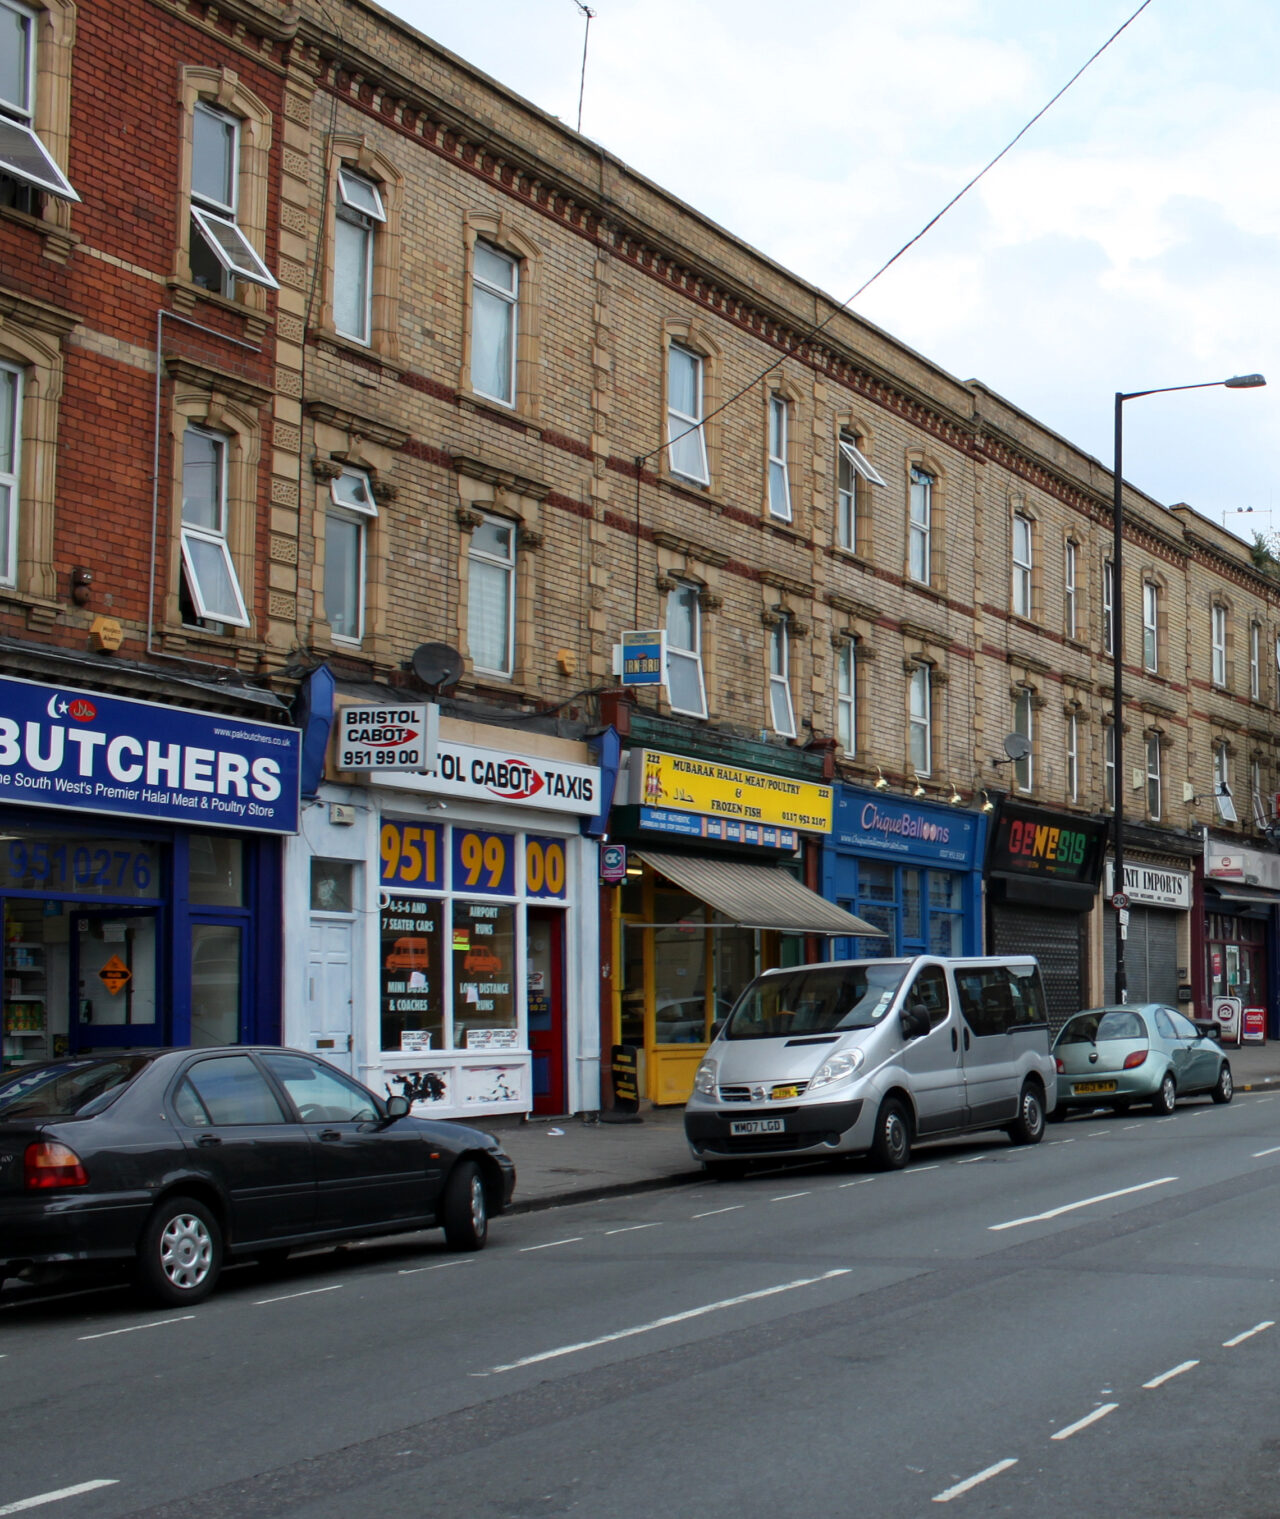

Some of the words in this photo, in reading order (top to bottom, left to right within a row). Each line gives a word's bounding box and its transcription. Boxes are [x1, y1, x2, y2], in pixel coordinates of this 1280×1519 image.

[624, 659, 660, 673] IRN-BRU
[346, 710, 420, 725] BRISTOL
[213, 727, 291, 747] www.pakbutchers.co.uk
[347, 728, 407, 743] CABOT
[343, 751, 372, 766] 951
[375, 750, 396, 765] 99
[399, 750, 419, 764] 00
[647, 753, 661, 764] 222
[471, 759, 532, 795] CABOT
[544, 771, 593, 801] TAXIS
[672, 760, 715, 778] MUBARAK
[716, 767, 743, 783] HALAL
[745, 774, 801, 795] MEAT/POULTRY
[15, 772, 51, 790] South
[55, 778, 92, 795] West's
[95, 784, 140, 801] Premier
[142, 789, 170, 804] Halal
[172, 793, 198, 808] Meat
[200, 796, 209, 809] &
[211, 798, 246, 817] Poultry
[248, 802, 275, 818] Store
[818, 788, 829, 799] 222
[711, 800, 743, 815] FROZEN
[744, 805, 762, 818] FISH
[782, 811, 797, 823] 0117
[799, 814, 811, 825] 952
[812, 816, 827, 828] 2107
[1009, 820, 1087, 865] GENESIS
[380, 824, 436, 882] 951
[460, 833, 505, 887] 99
[526, 841, 565, 894] 00
[1143, 871, 1183, 896] IMPORTS
[389, 901, 411, 914] 4-5-6
[412, 902, 428, 914] AND
[1114, 896, 1124, 905] 20
[469, 906, 498, 919] AIRPORT
[382, 919, 388, 930] 7
[389, 919, 415, 931] SEATER
[415, 920, 434, 932] CARS
[474, 923, 494, 935] RUNS
[387, 981, 405, 993] MINI
[479, 983, 509, 994] DISTANCE
[389, 1000, 396, 1011] &
[396, 1000, 428, 1012] COACHES
[476, 1000, 494, 1011] RUNS
[734, 1121, 759, 1133] WM07
[761, 1120, 781, 1131] LGD
